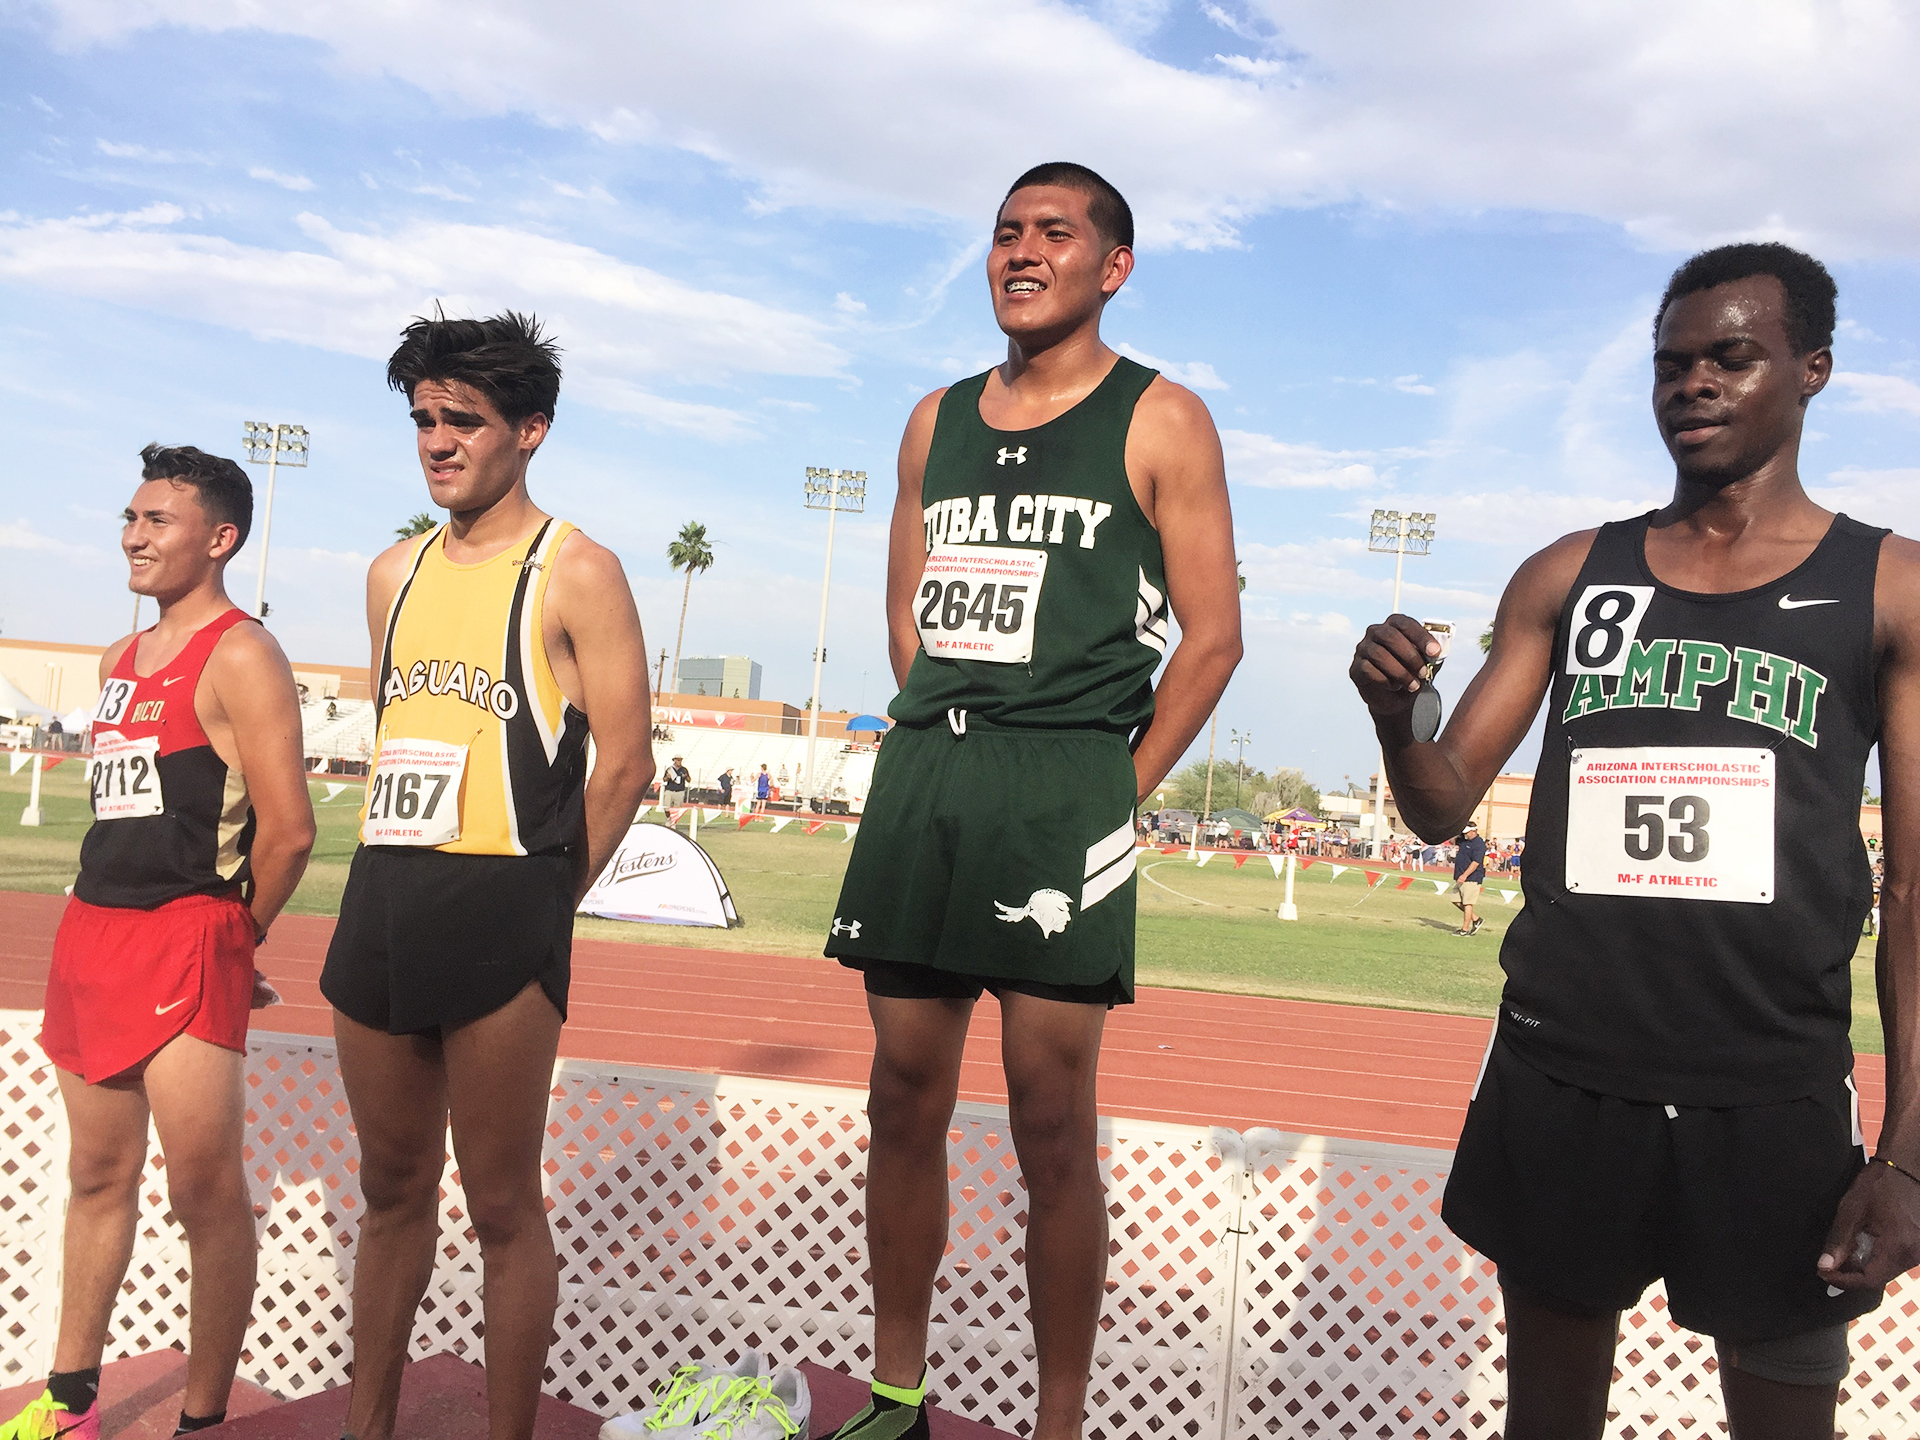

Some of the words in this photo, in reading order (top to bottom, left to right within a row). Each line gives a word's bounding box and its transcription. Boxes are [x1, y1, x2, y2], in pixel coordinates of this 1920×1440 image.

[923, 494, 999, 553] TUBA
[1006, 494, 1113, 550] CITY
[928, 555, 958, 563] ARIZONA
[959, 556, 1036, 568] INTERSCHOLASTIC
[969, 566, 1040, 578] CHAMPIONSHIPS
[920, 579, 1029, 635] 2645
[936, 640, 950, 649] M-F
[951, 641, 994, 651] ATHLETIC
[1574, 590, 1636, 669] 8
[96, 680, 129, 721] 13
[130, 700, 166, 724] RICO
[1562, 638, 1828, 749] AMPHI
[93, 755, 152, 799] 2112
[1577, 775, 1657, 785] ASSOCIATION
[1660, 775, 1770, 788] CHAMPIONSHIPS
[1586, 762, 1638, 772] ARIZONA
[1641, 762, 1761, 774] INTERSCHOLASTIC
[369, 772, 451, 820] 2167
[1624, 795, 1711, 863] 53
[598, 847, 677, 889] Jostens
[1617, 873, 1644, 884] M-F
[1648, 874, 1718, 888] ATHLETIC
